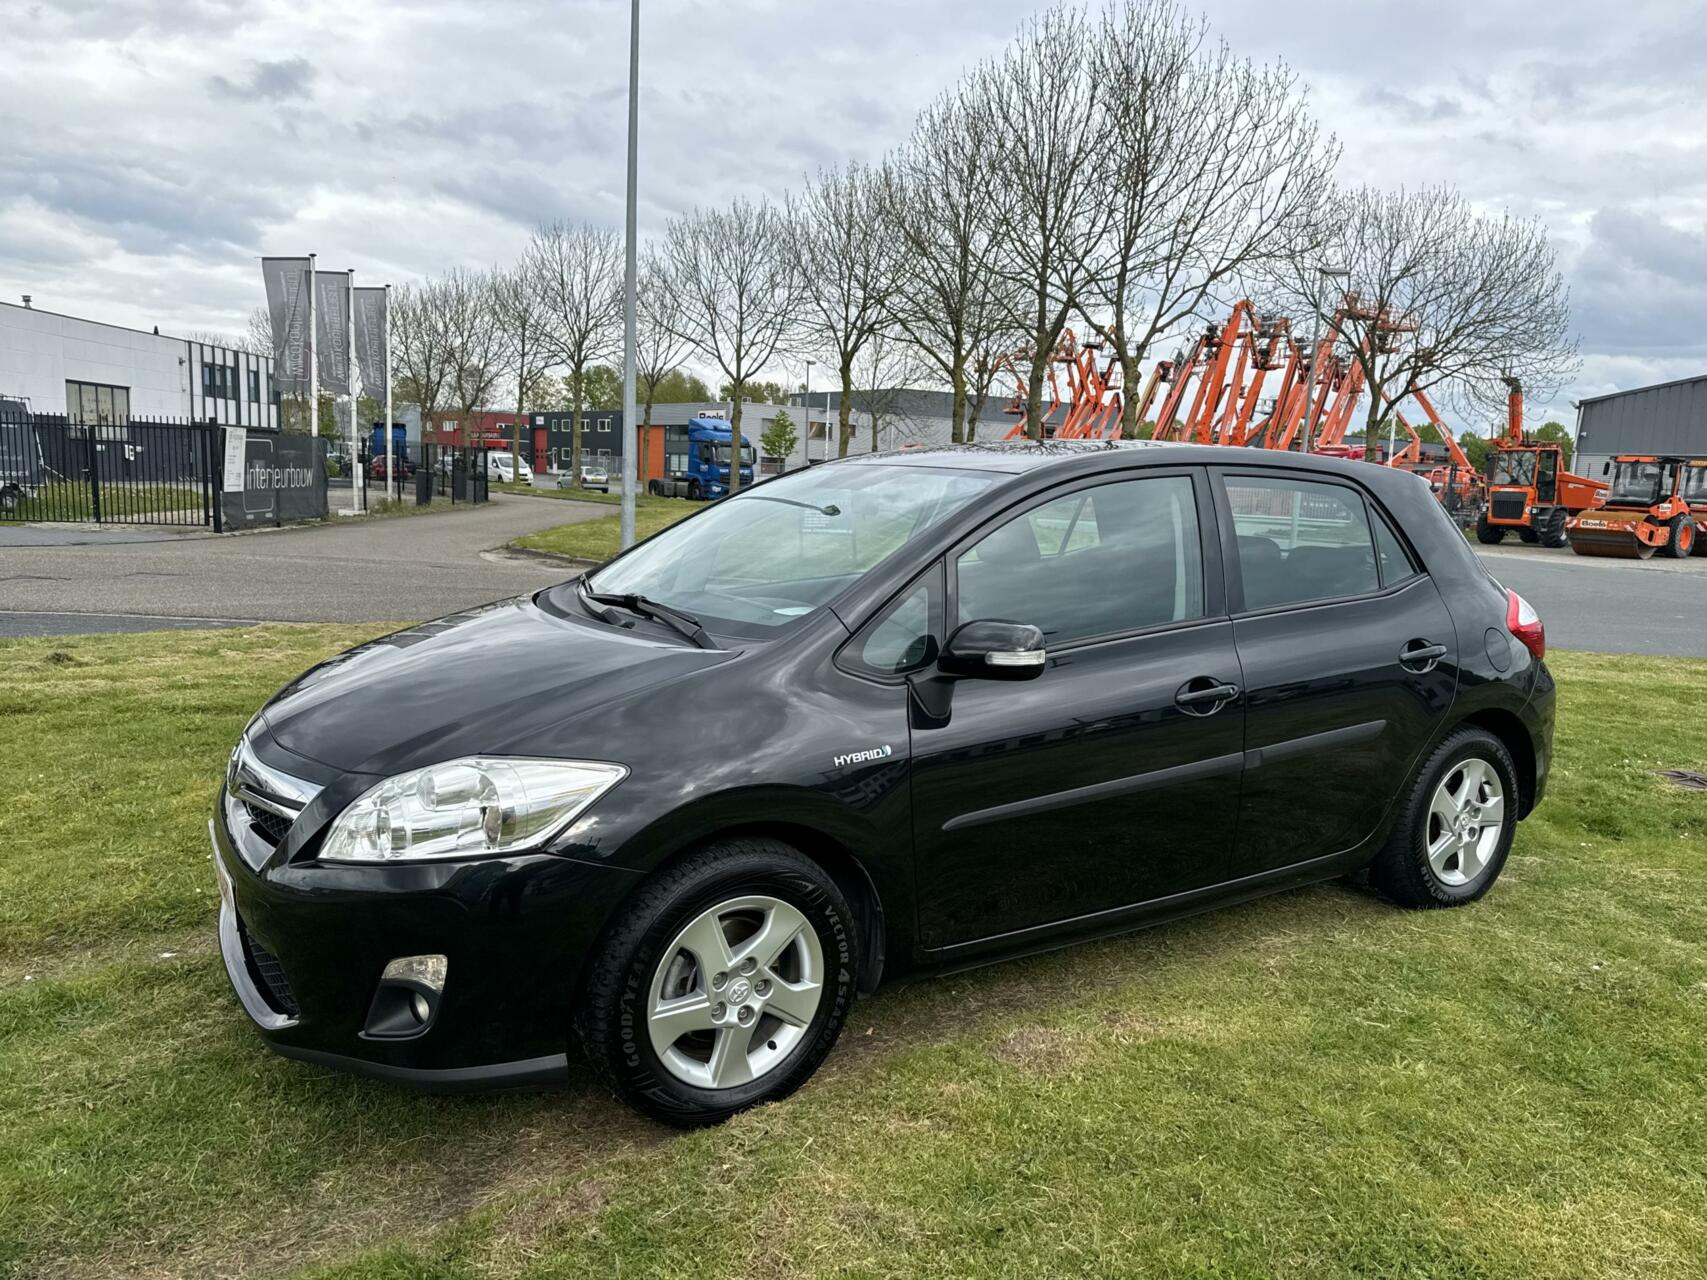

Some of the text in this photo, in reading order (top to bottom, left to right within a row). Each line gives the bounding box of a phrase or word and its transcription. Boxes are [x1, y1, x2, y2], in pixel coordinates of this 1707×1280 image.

[246, 461, 314, 490] Interieurbouw
[833, 748, 885, 767] HYBRID
[824, 904, 851, 965] VECTOR
